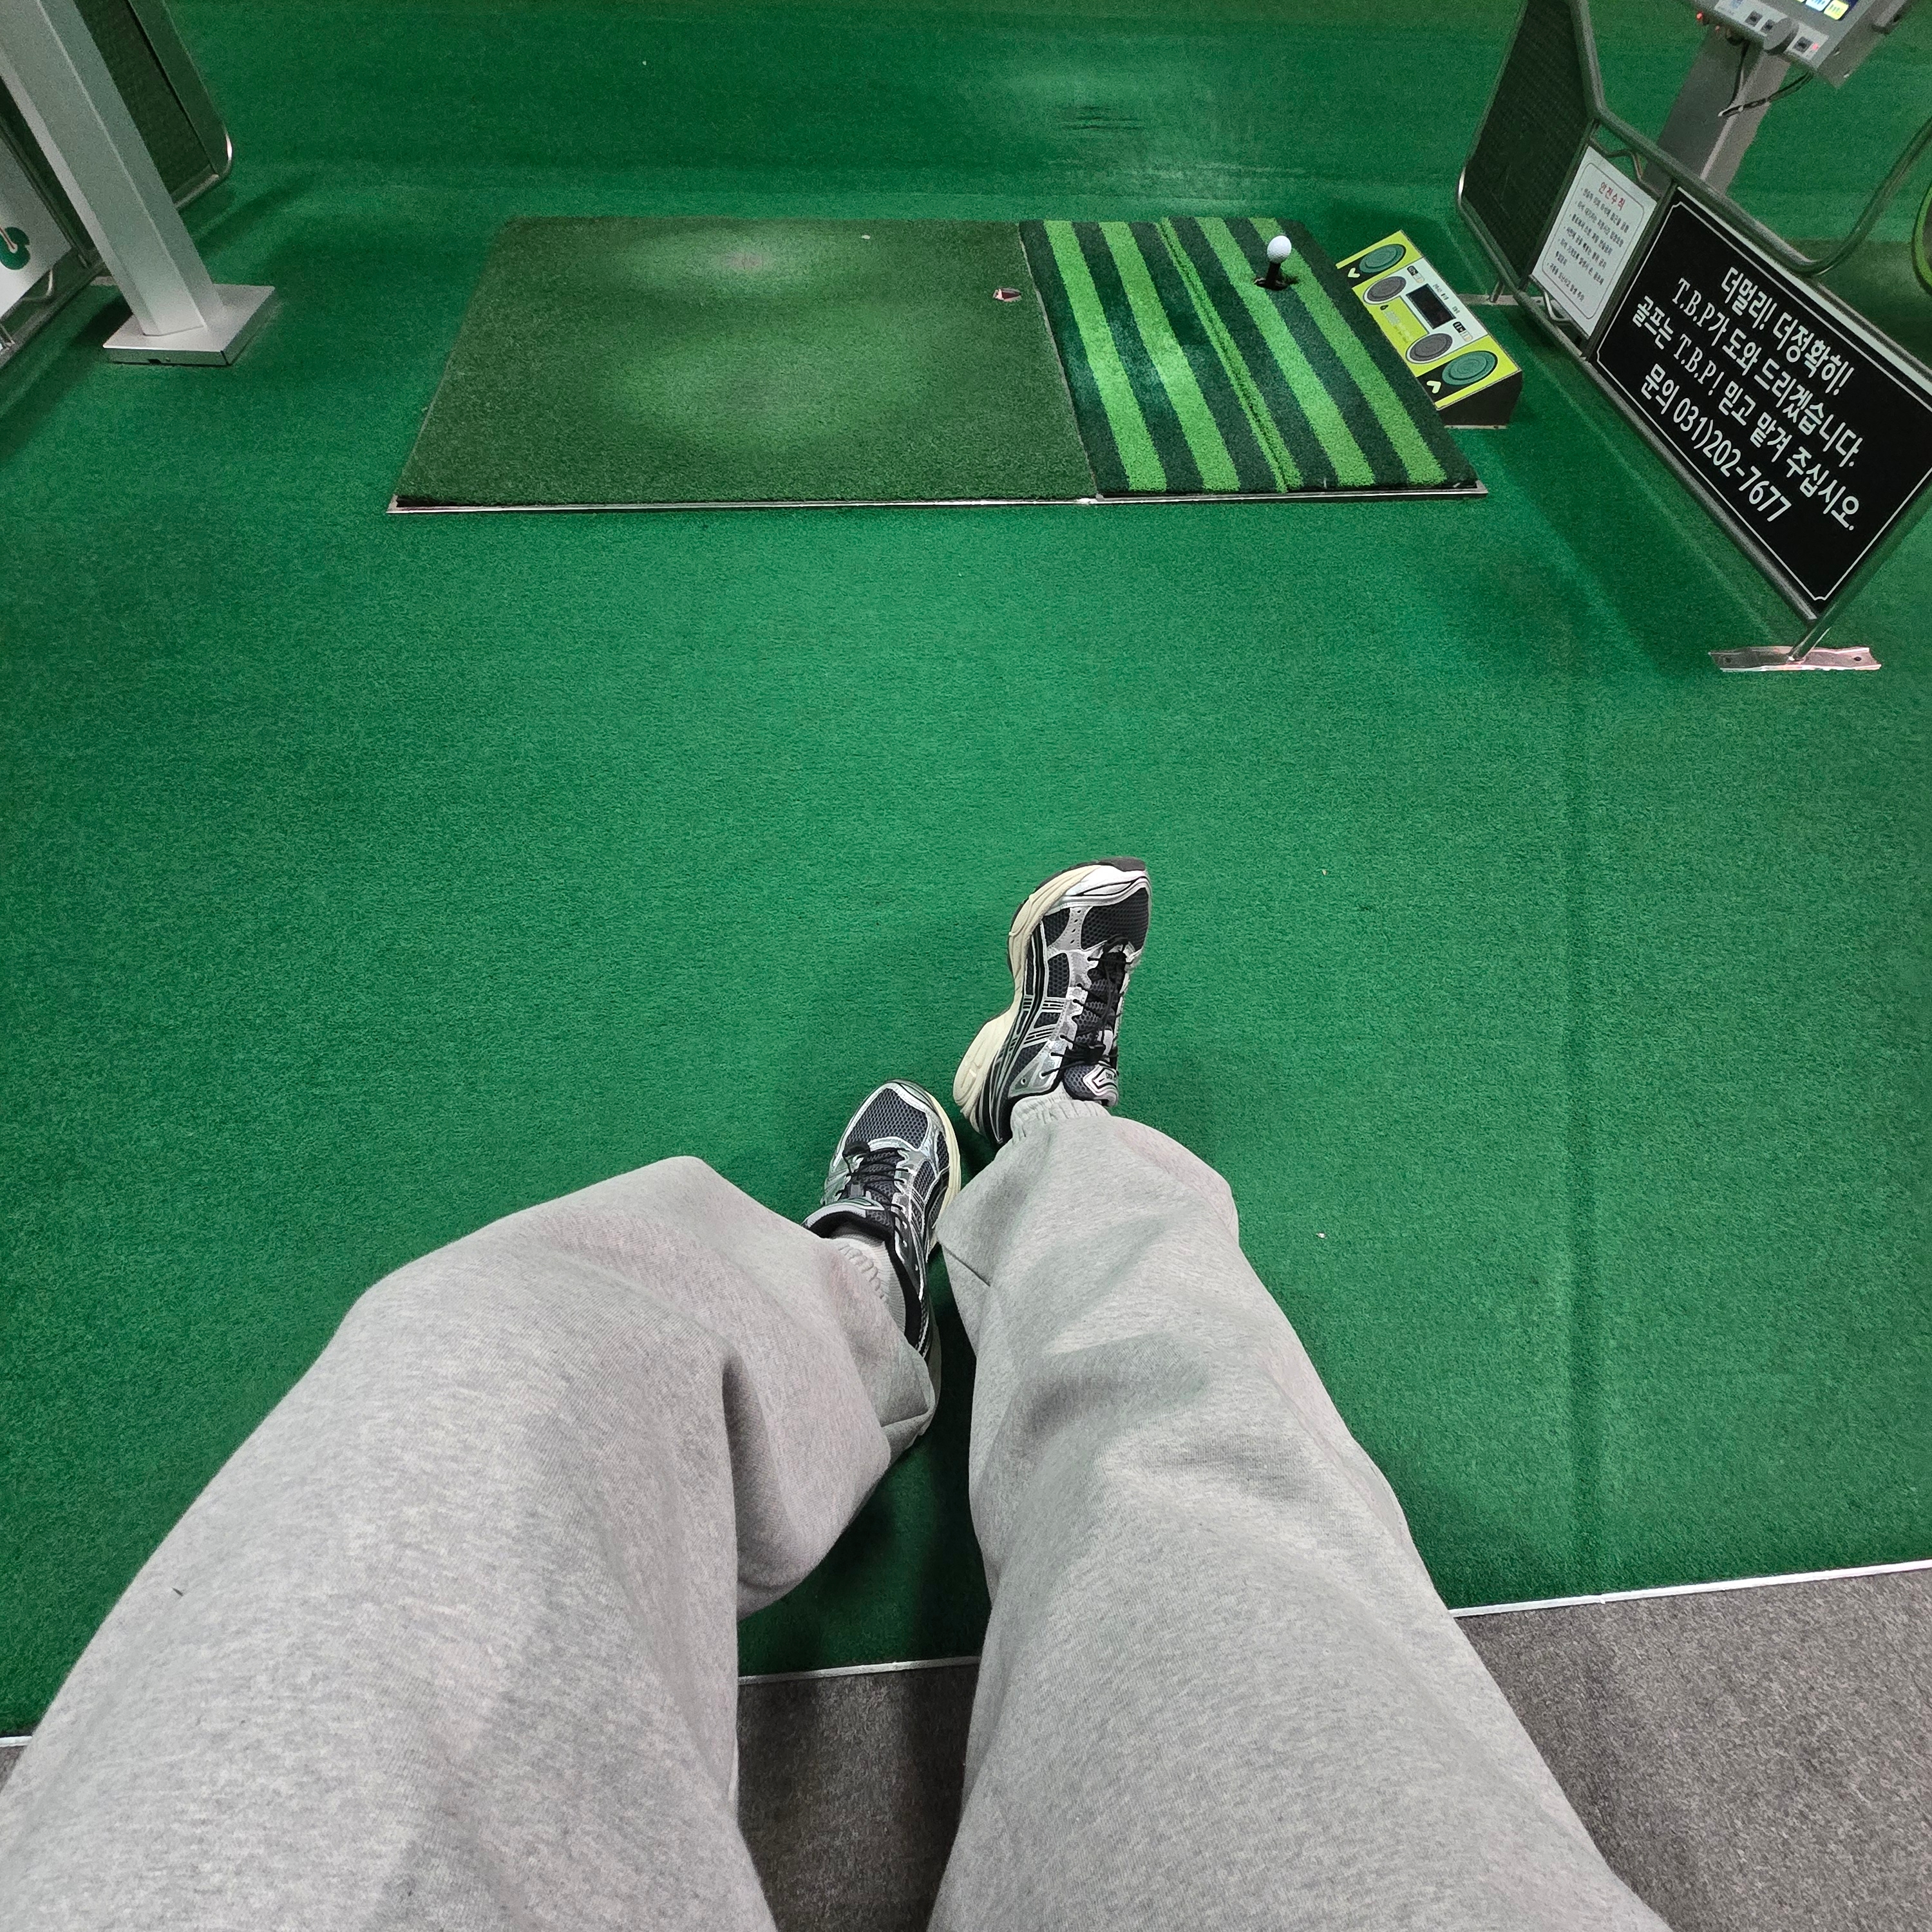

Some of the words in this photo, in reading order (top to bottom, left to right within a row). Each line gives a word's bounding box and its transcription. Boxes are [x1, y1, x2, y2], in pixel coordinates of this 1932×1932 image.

[1632, 295, 1674, 350] 골프는
[1673, 333, 1725, 396] T.B.P!
[1718, 381, 1756, 426] 믿고
[1749, 412, 1793, 462] 맡겨
[1786, 446, 1860, 531] 주십시오.
[1672, 277, 1730, 346] T.B.P가
[1721, 328, 1762, 376] 도와
[1754, 358, 1863, 468] 드리겠습니다.
[1721, 267, 1777, 330] 더멀리!
[1772, 312, 1855, 396] 더정확히!
[1640, 363, 1680, 415] 문의
[1672, 397, 1792, 522] 031)202-7677
